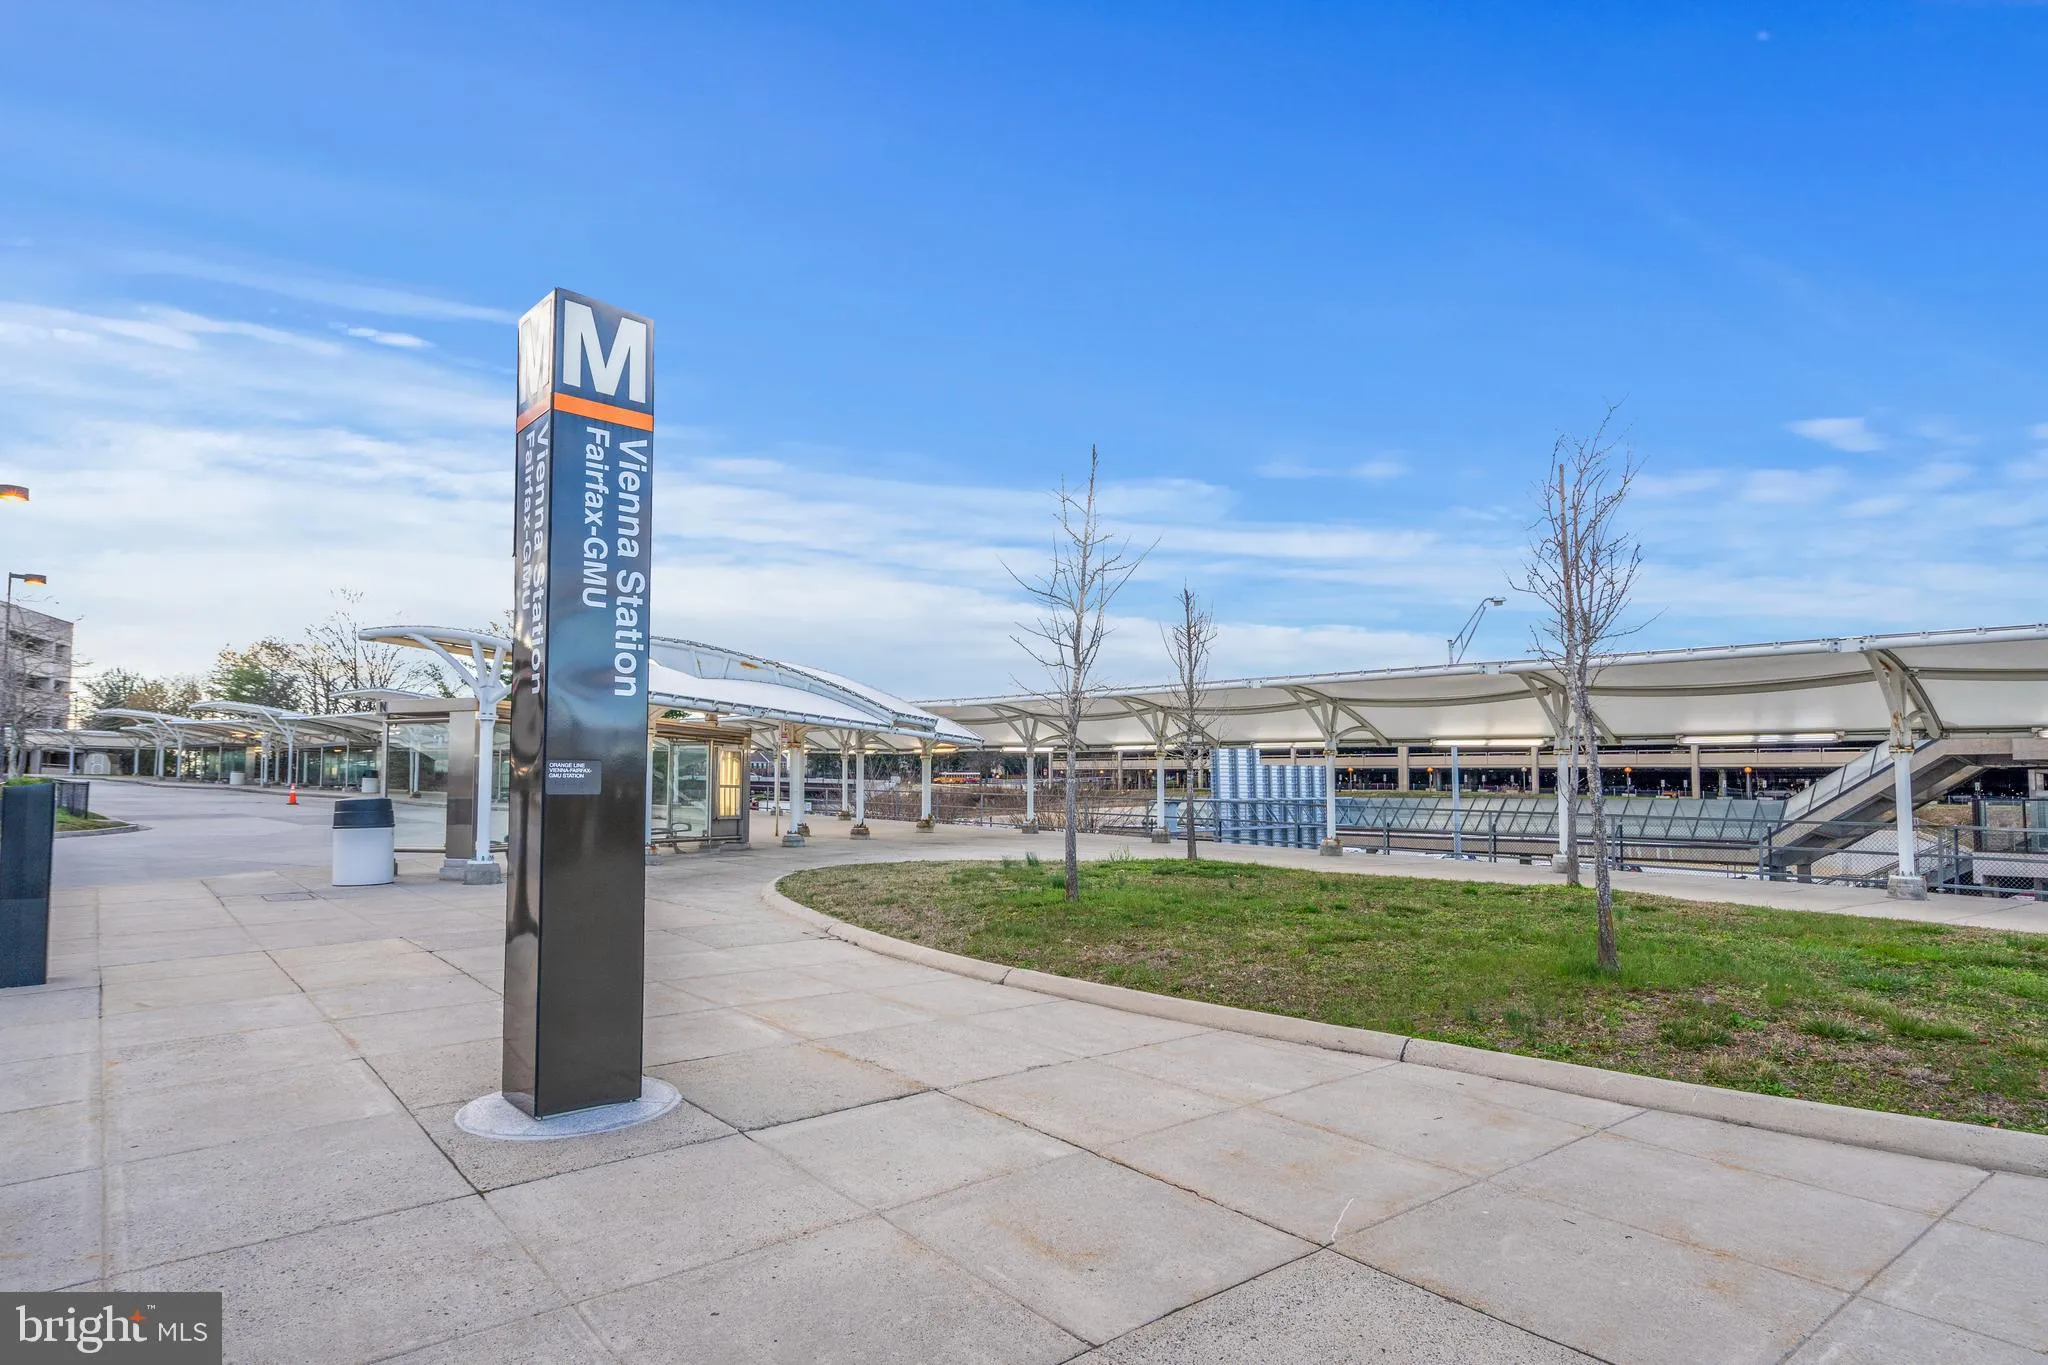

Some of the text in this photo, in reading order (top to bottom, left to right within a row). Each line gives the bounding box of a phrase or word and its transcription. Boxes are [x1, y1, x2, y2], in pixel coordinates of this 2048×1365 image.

[519, 299, 552, 405] M
[563, 299, 647, 404] M
[521, 430, 536, 610] Fairfax-GMU
[531, 421, 549, 695] Vienna Station
[582, 426, 610, 609] Fairfax-GMU
[614, 439, 648, 697] Vienna Station
